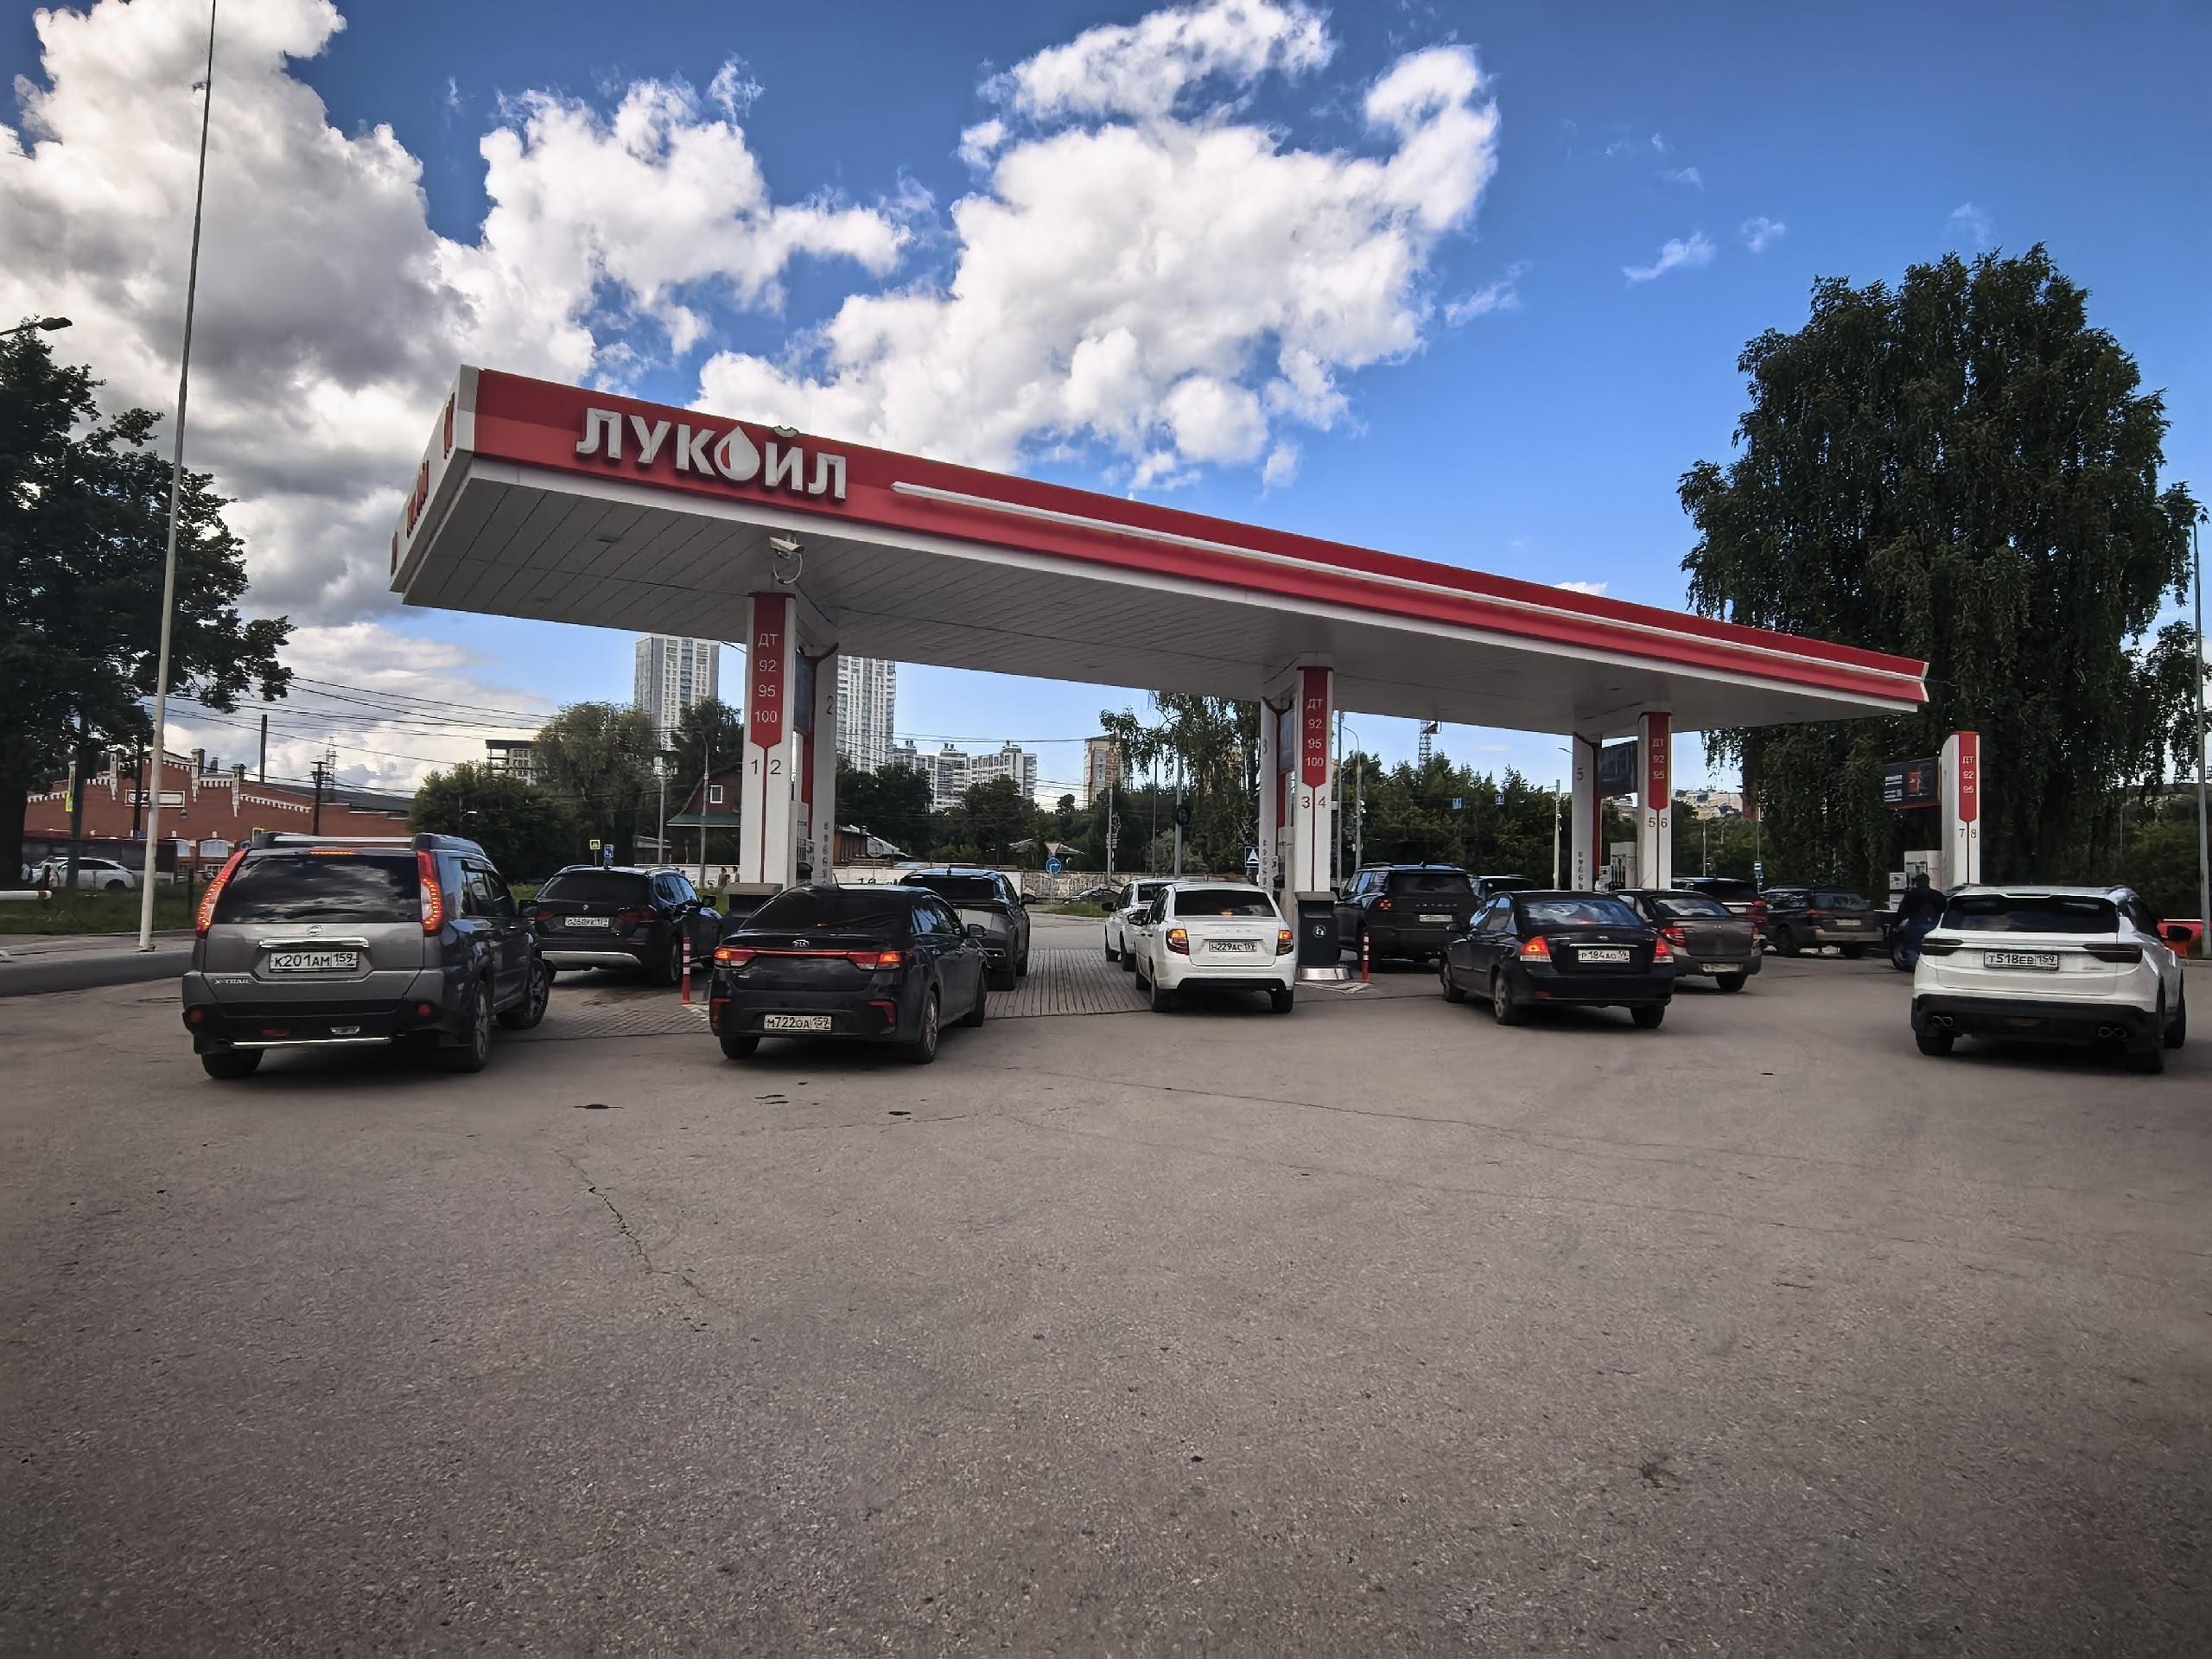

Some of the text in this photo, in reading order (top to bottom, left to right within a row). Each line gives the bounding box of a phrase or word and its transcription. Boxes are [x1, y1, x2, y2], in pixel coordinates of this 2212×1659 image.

[575, 407, 846, 499] ЛУКОЙЛ
[757, 633, 779, 647] ДТ
[759, 659, 777, 672] 92
[759, 685, 776, 697] 95
[1307, 698, 1324, 709] ДТ
[754, 710, 778, 723] 100
[1307, 719, 1322, 729] 92
[1307, 739, 1322, 749] 95
[1306, 757, 1324, 767] 100
[1652, 754, 1665, 764] 92
[750, 759, 782, 775] 1 2
[1301, 796, 1326, 809] 3 4
[1648, 817, 1668, 828] 5 6
[1958, 828, 1977, 839] 7 8
[274, 953, 353, 968] К201АМ 159
